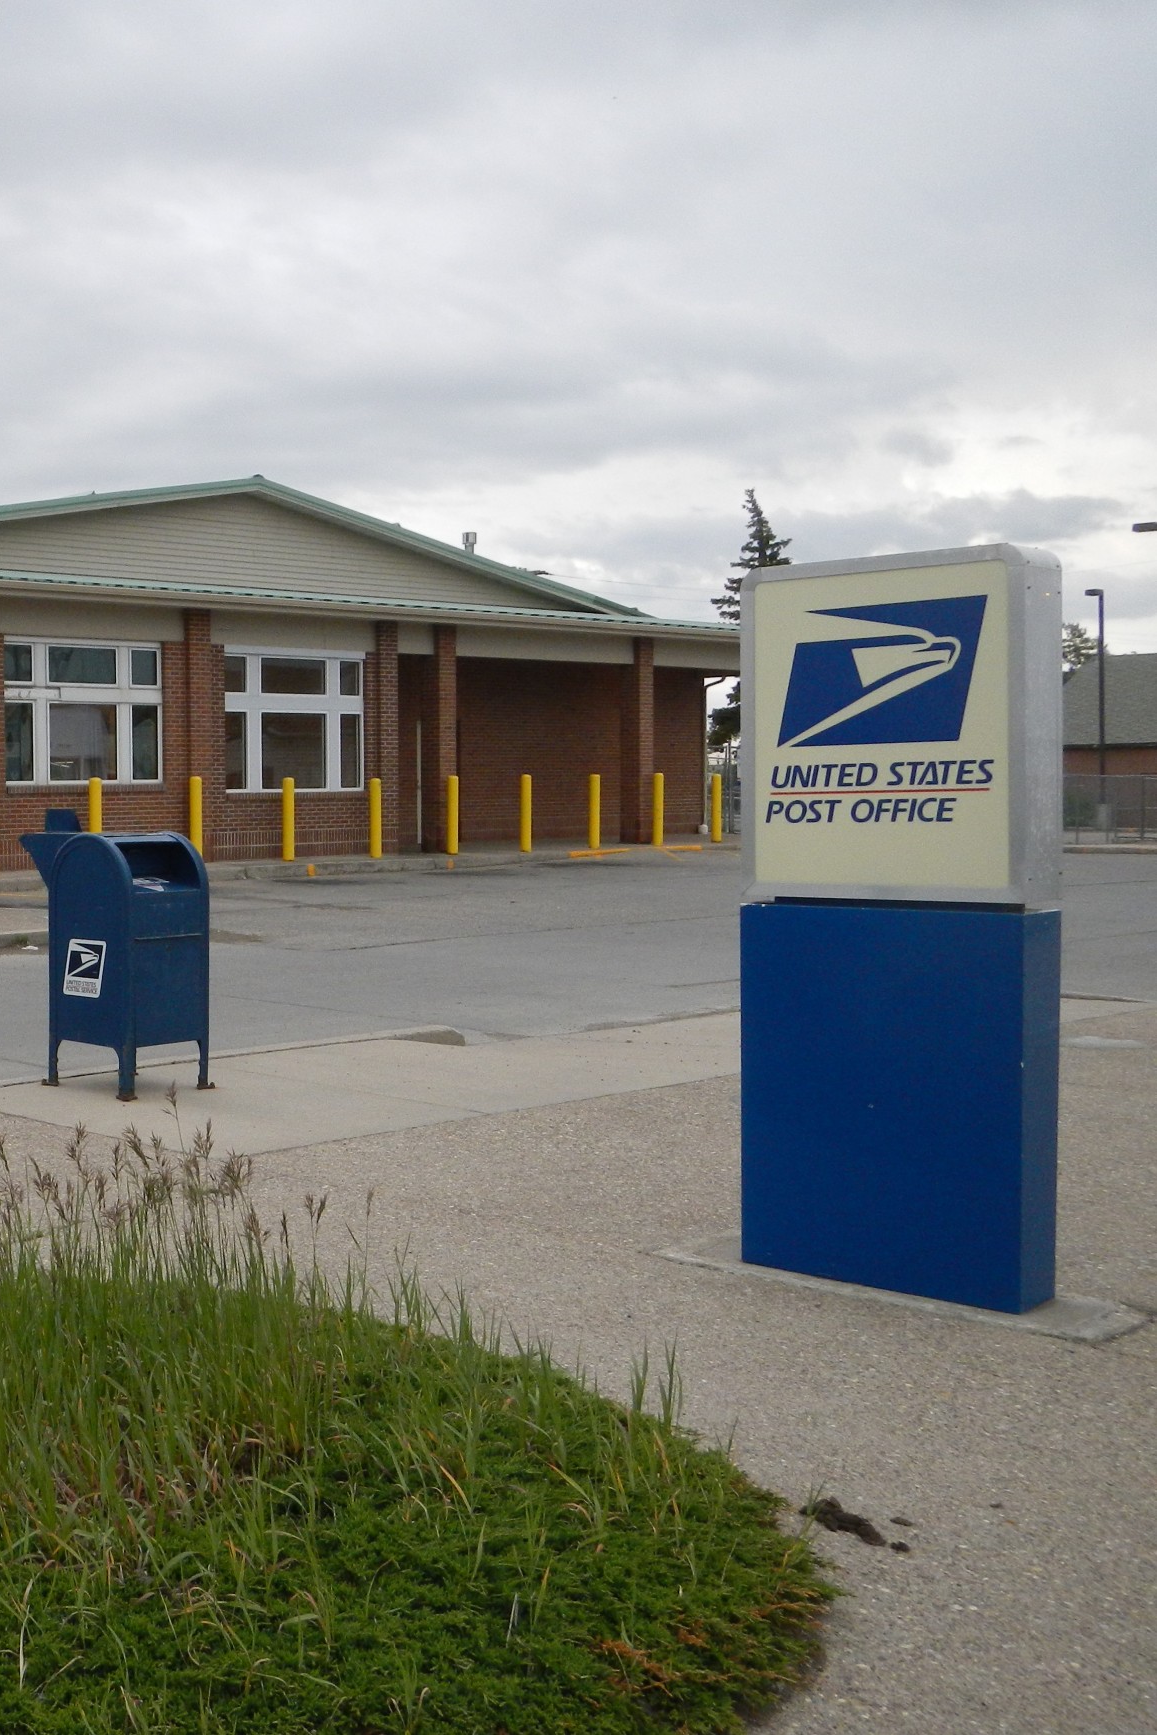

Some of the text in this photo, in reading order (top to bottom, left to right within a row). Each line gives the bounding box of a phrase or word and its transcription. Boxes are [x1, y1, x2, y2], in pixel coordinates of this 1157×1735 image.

[771, 760, 994, 788] UNITED STATES
[766, 798, 957, 823] POST OFFICE
